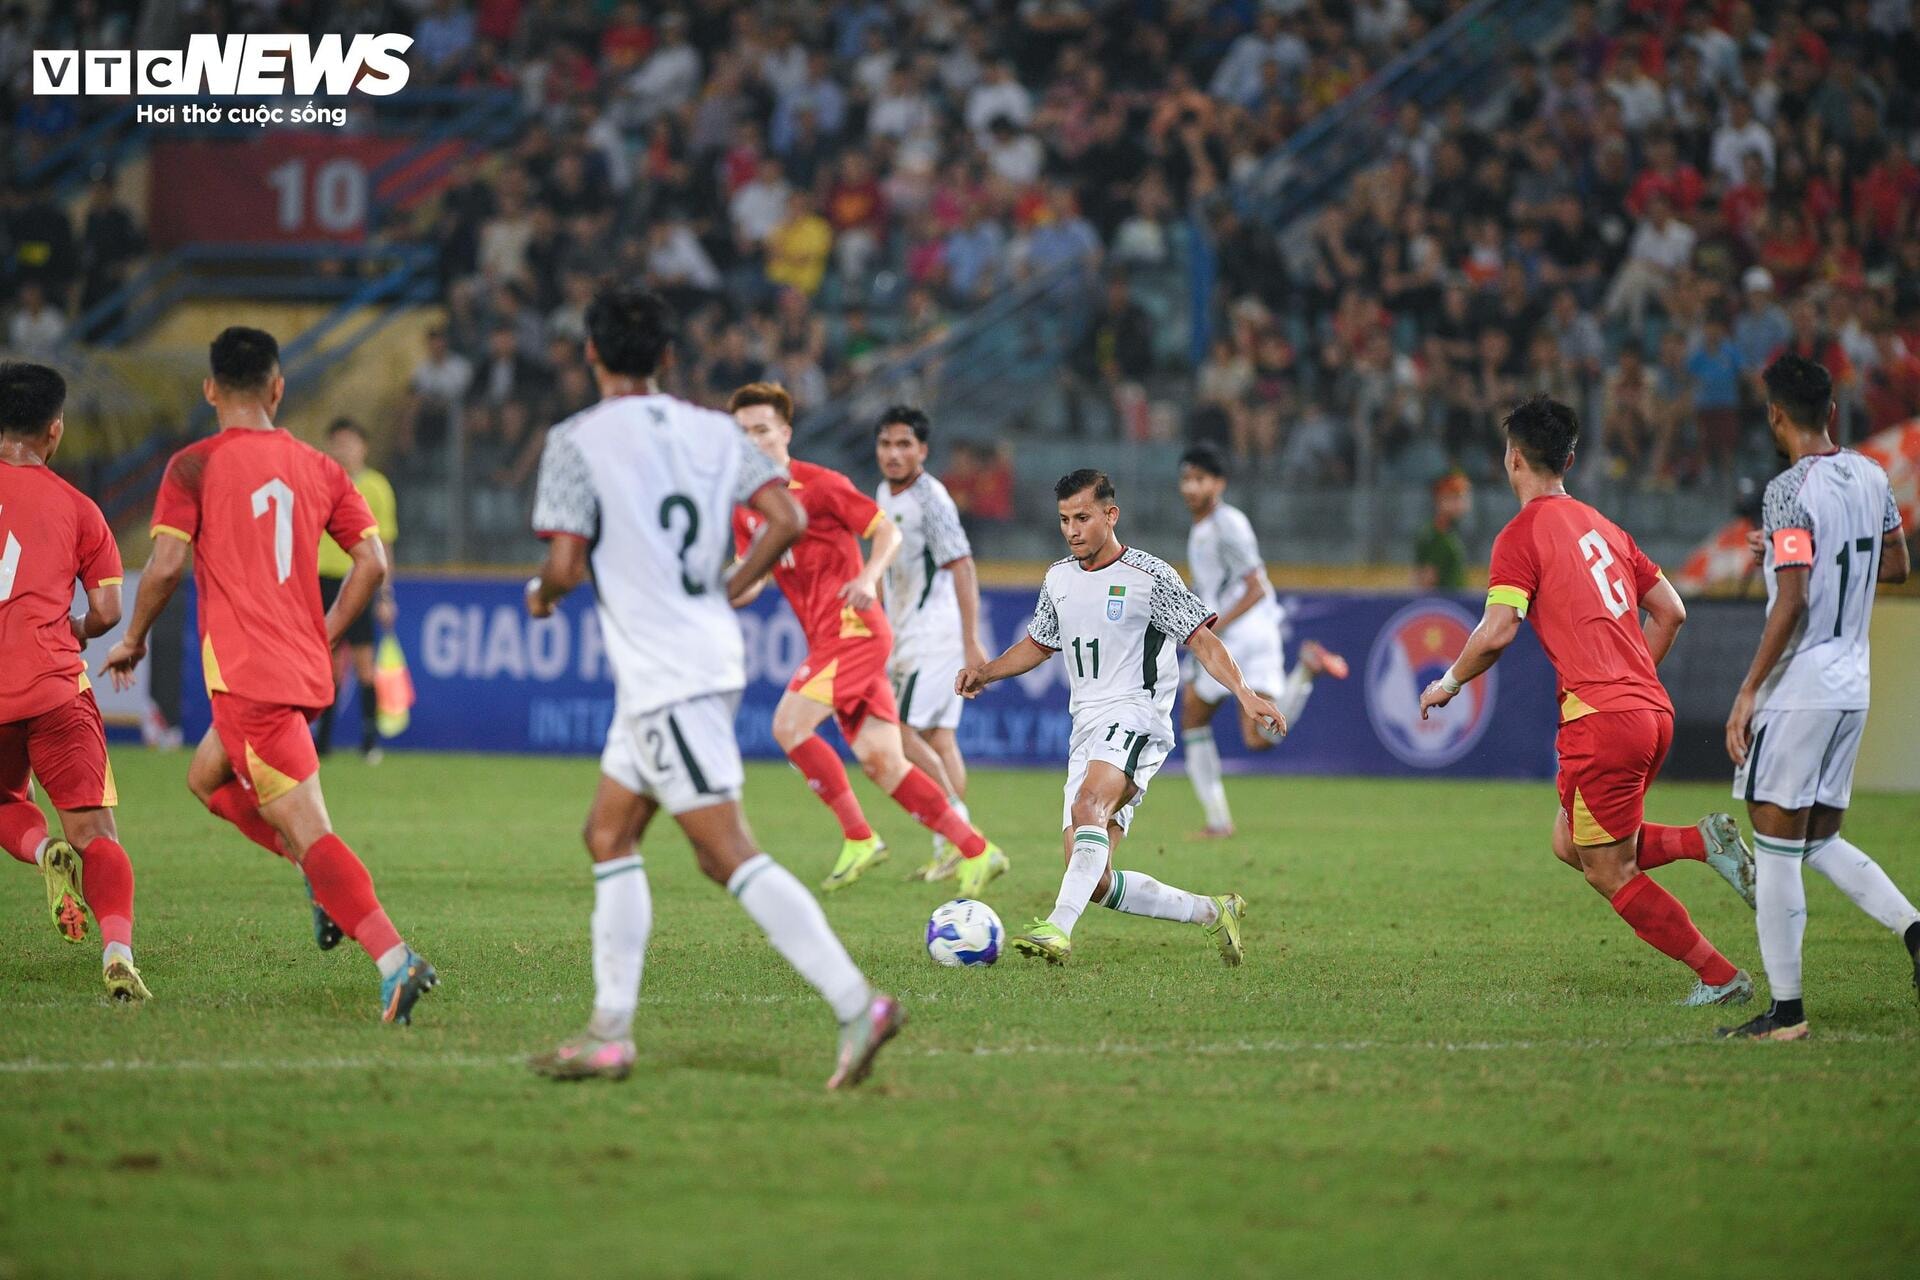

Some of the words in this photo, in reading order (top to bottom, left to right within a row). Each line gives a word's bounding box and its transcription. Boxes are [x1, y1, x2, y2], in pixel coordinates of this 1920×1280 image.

[268, 159, 369, 231] 10
[660, 495, 705, 595] 2
[1578, 528, 1630, 620] 2
[1783, 535, 1798, 554] C
[1836, 536, 1875, 637] 17
[420, 603, 571, 681] GIAO
[1072, 636, 1099, 679] 11
[646, 728, 672, 772] 2
[1104, 722, 1136, 751] 11
